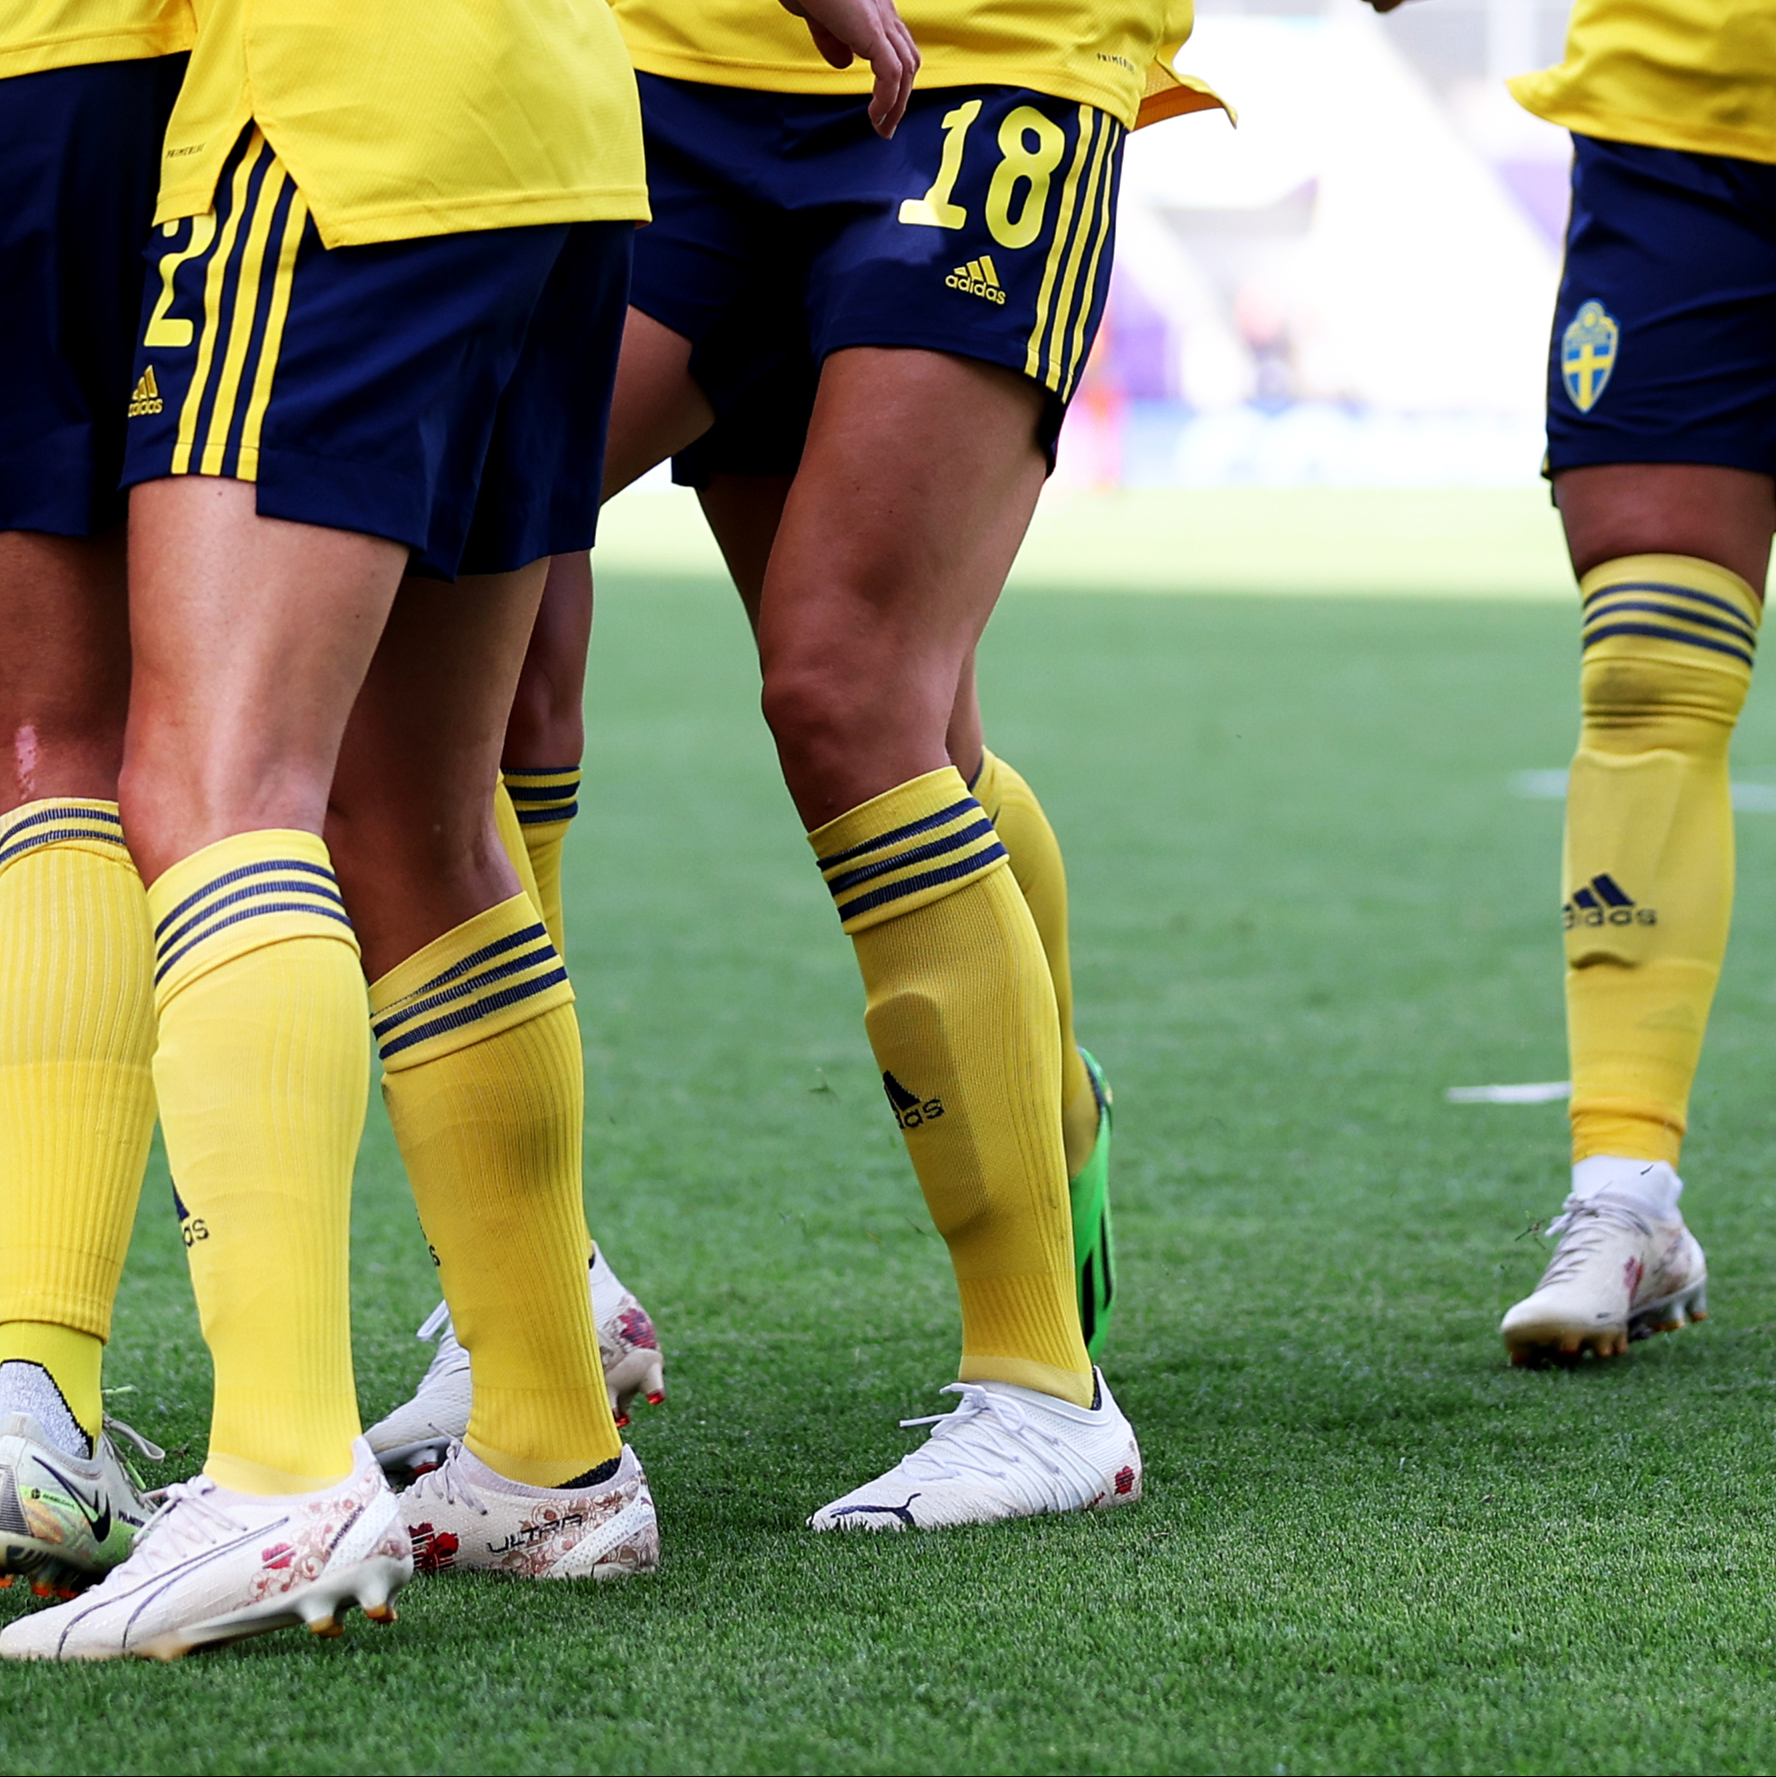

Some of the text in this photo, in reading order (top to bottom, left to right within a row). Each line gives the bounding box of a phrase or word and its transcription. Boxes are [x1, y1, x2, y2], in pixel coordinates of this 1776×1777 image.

[898, 99, 1066, 249] 18
[143, 211, 217, 347] 2
[945, 273, 1006, 305] adidas
[487, 1513, 583, 1554] ULTRA
